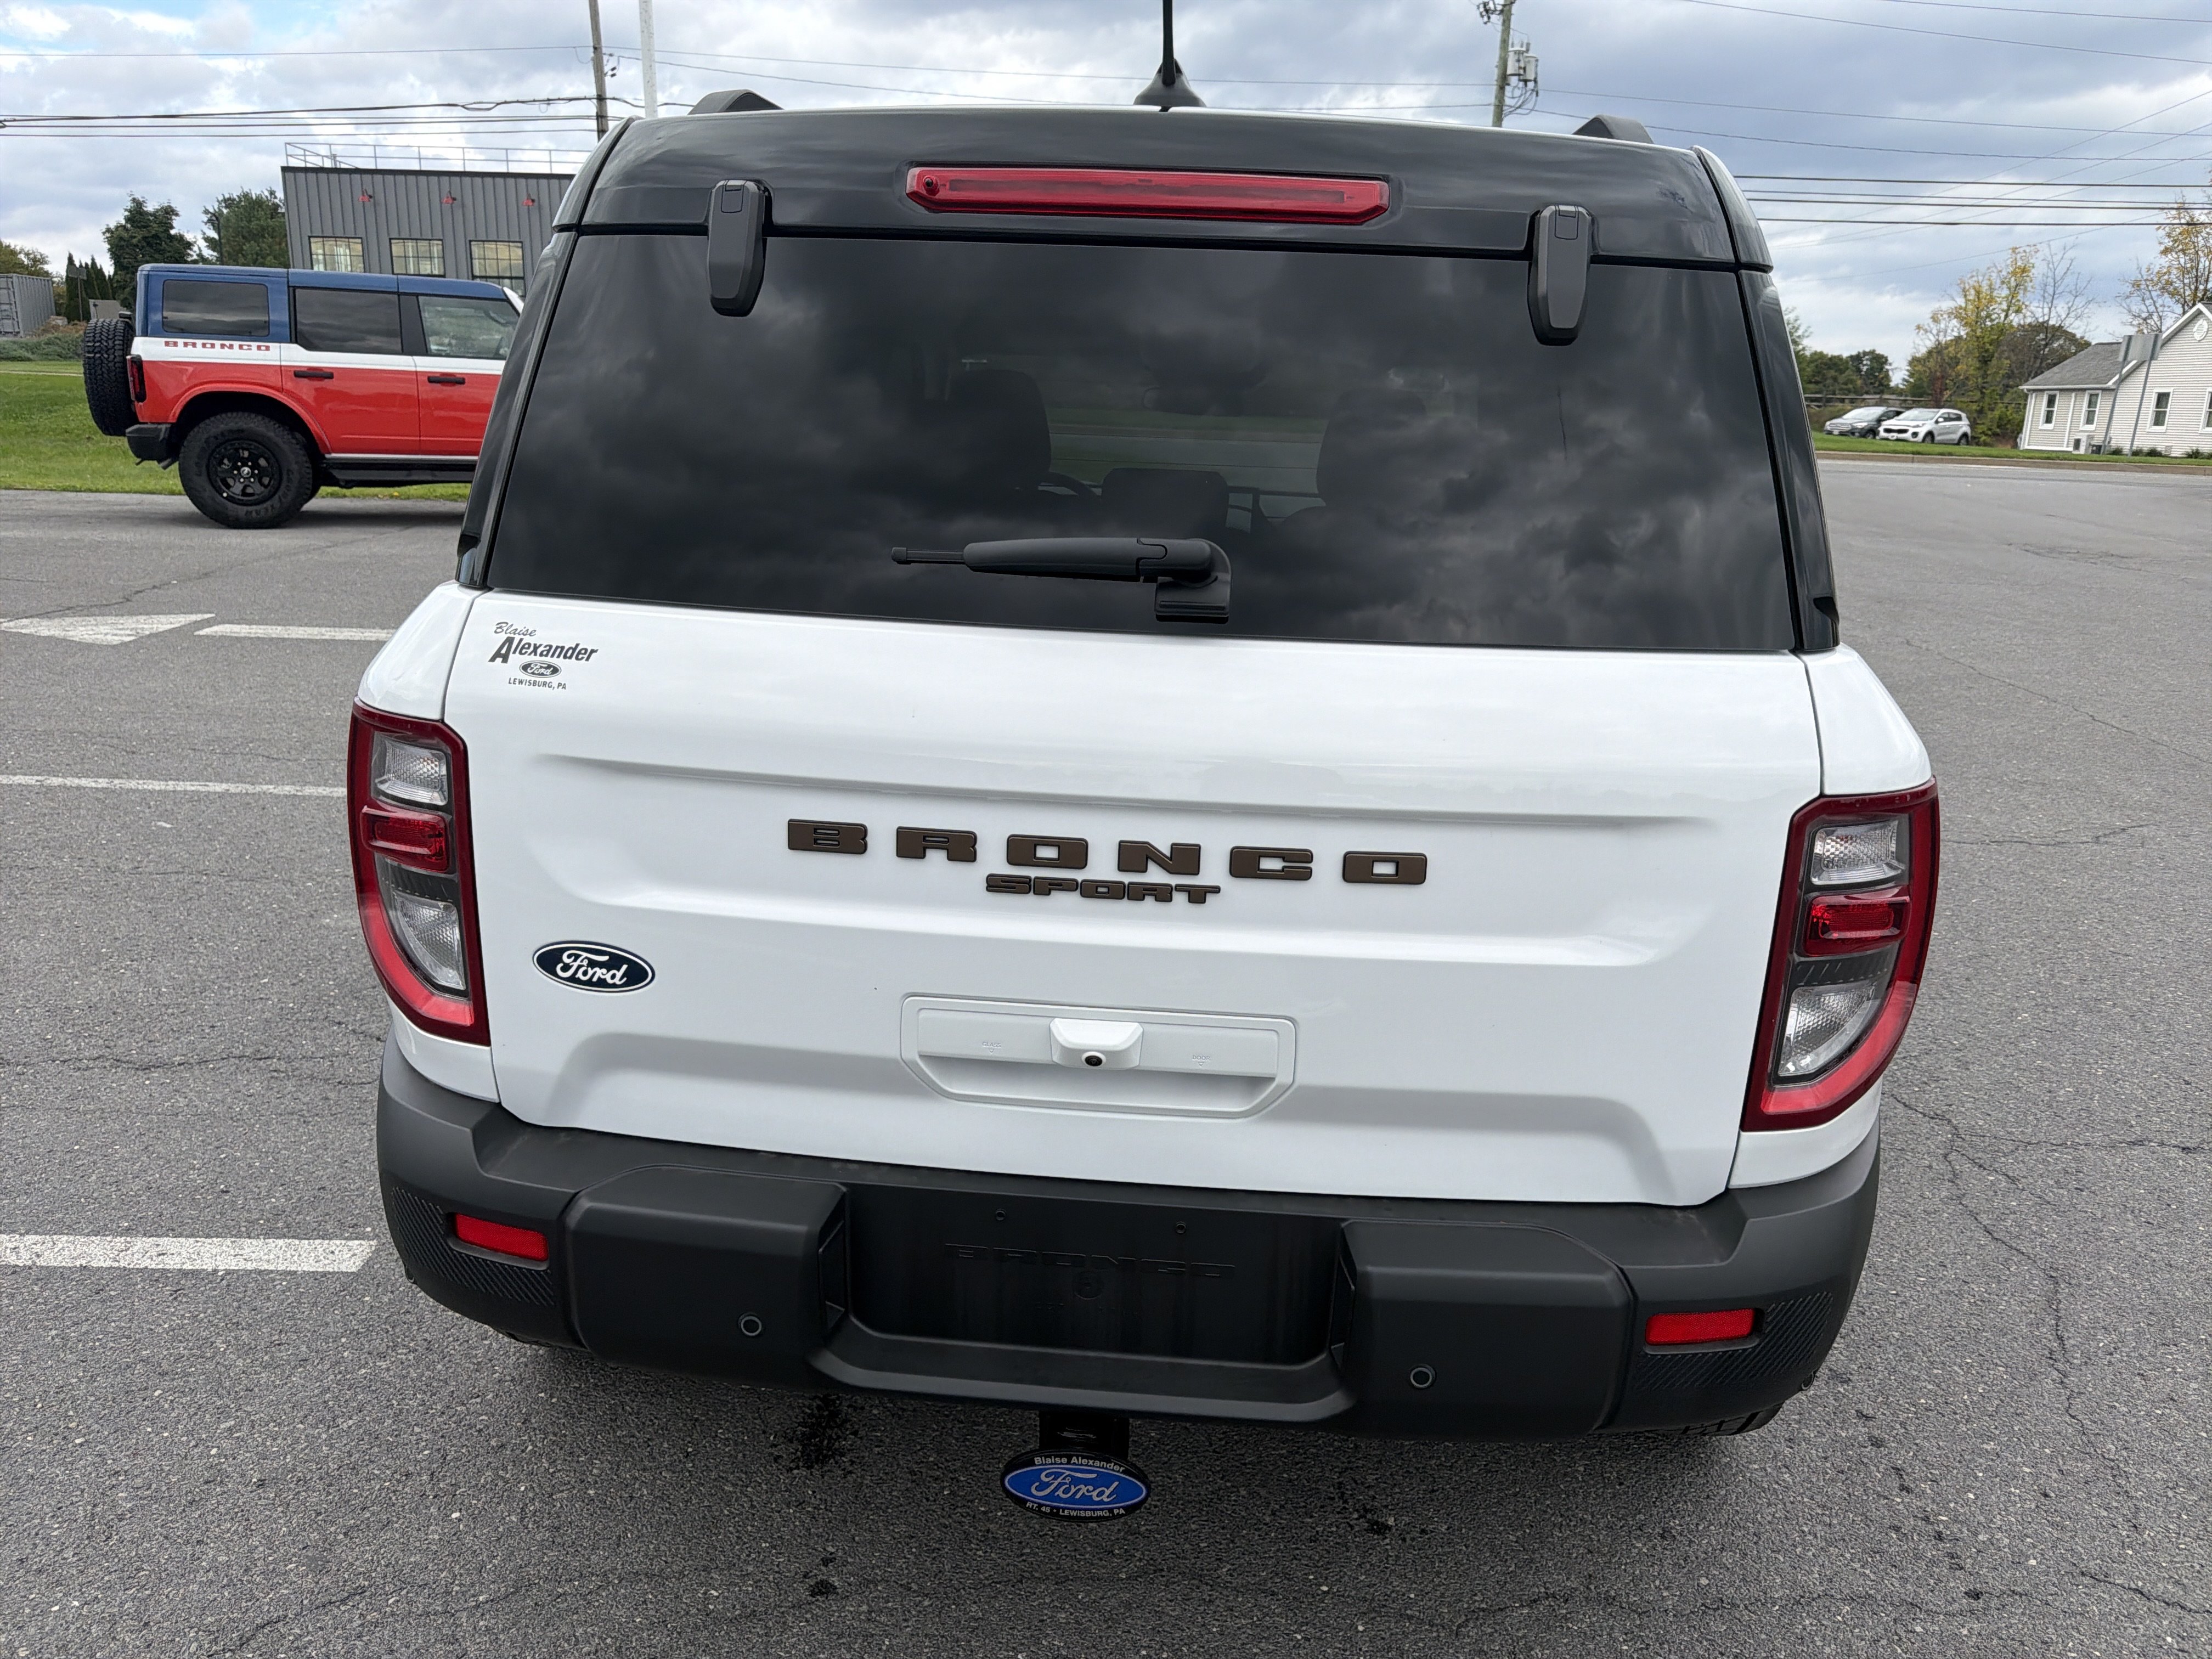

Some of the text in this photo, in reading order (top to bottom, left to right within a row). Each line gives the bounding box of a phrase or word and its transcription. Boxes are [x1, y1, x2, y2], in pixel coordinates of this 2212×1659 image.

[164, 340, 270, 351] BRONCO
[494, 622, 537, 636] Blaise
[488, 636, 599, 664] Alexander
[527, 662, 554, 675] Ford
[508, 678, 555, 690] LEWISBURG,
[788, 819, 1427, 885] BRONCO
[986, 873, 1221, 904] SPORT
[556, 950, 628, 985] Ford
[1034, 1456, 1125, 1473] Blaise Alexander
[1031, 1469, 1119, 1502] Ford
[1026, 1501, 1039, 1510] RT.
[1059, 1509, 1113, 1517] LEWISBURG,
